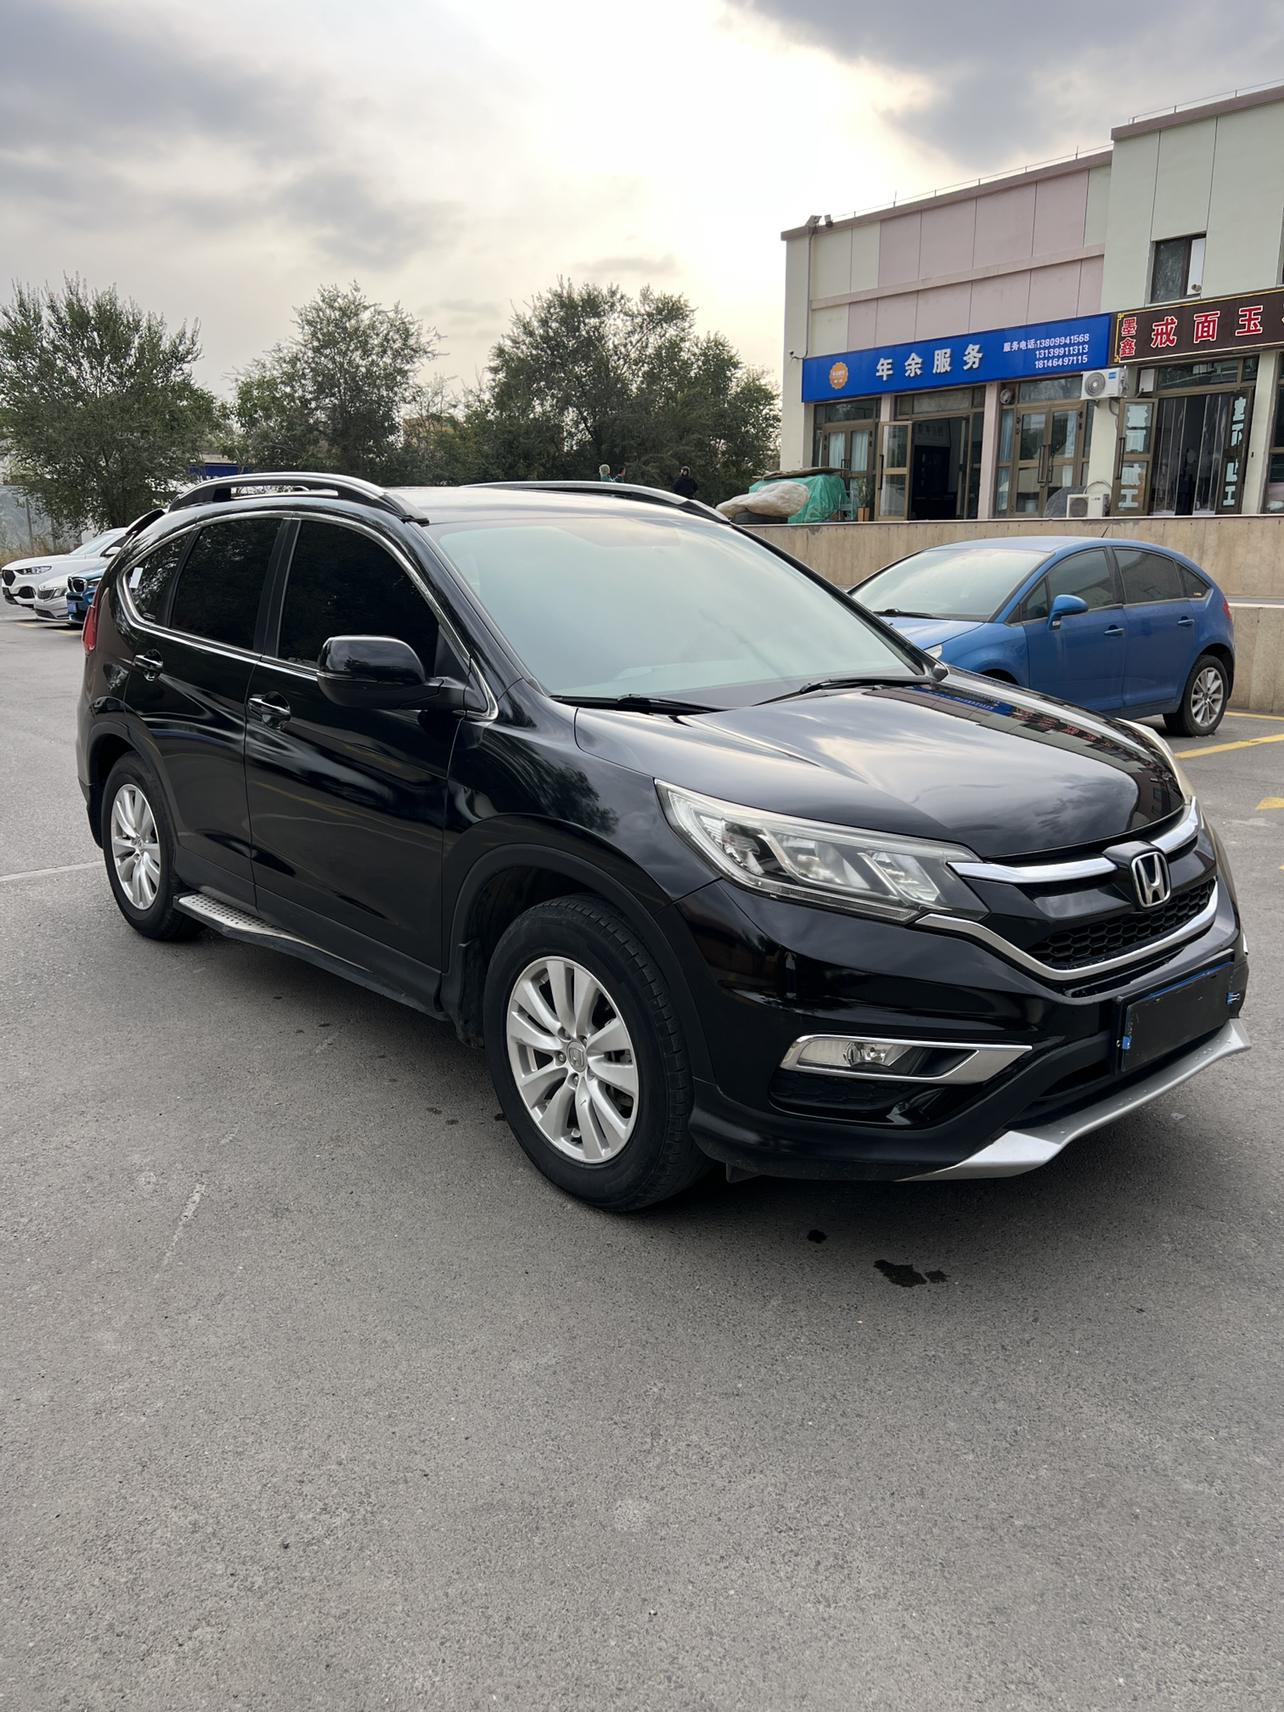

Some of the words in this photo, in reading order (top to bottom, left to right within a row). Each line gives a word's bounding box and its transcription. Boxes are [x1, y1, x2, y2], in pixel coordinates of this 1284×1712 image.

[1151, 305, 1284, 348] 戒面玉
[876, 344, 984, 381] 年余服务
[1034, 355, 1088, 369] 18146497115
[1035, 345, 1089, 359] 13139911313
